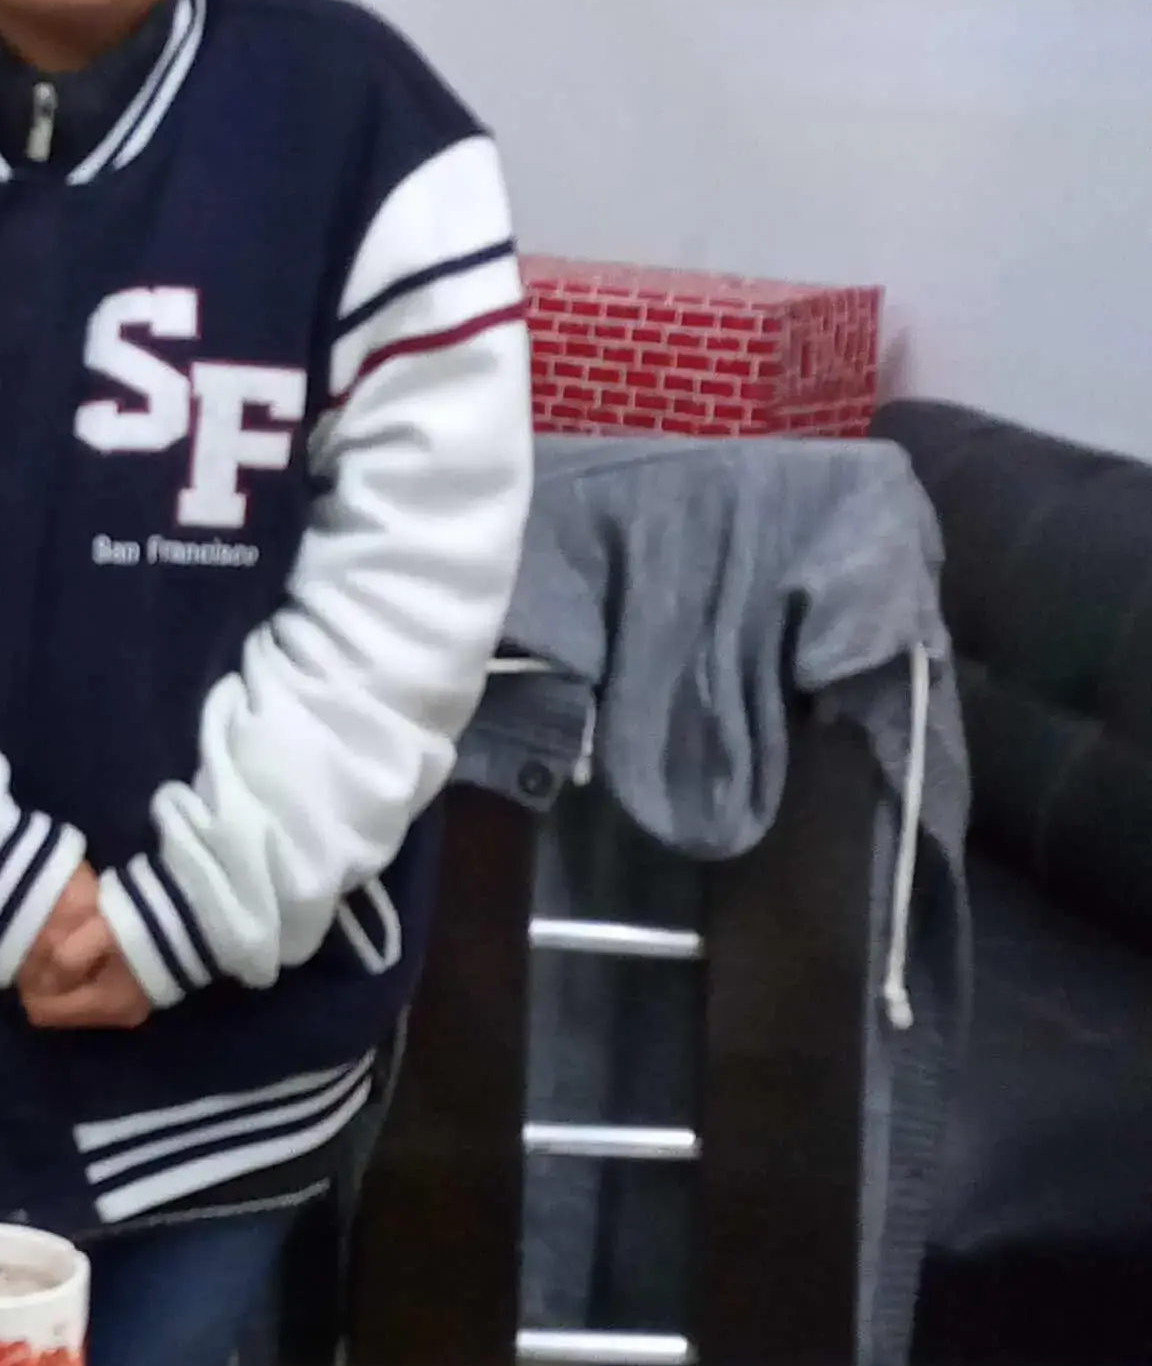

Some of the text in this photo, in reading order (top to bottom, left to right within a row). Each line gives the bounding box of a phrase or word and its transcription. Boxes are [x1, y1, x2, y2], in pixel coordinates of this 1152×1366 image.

[74, 286, 307, 529] SF
[92, 534, 260, 567] San Francisco
